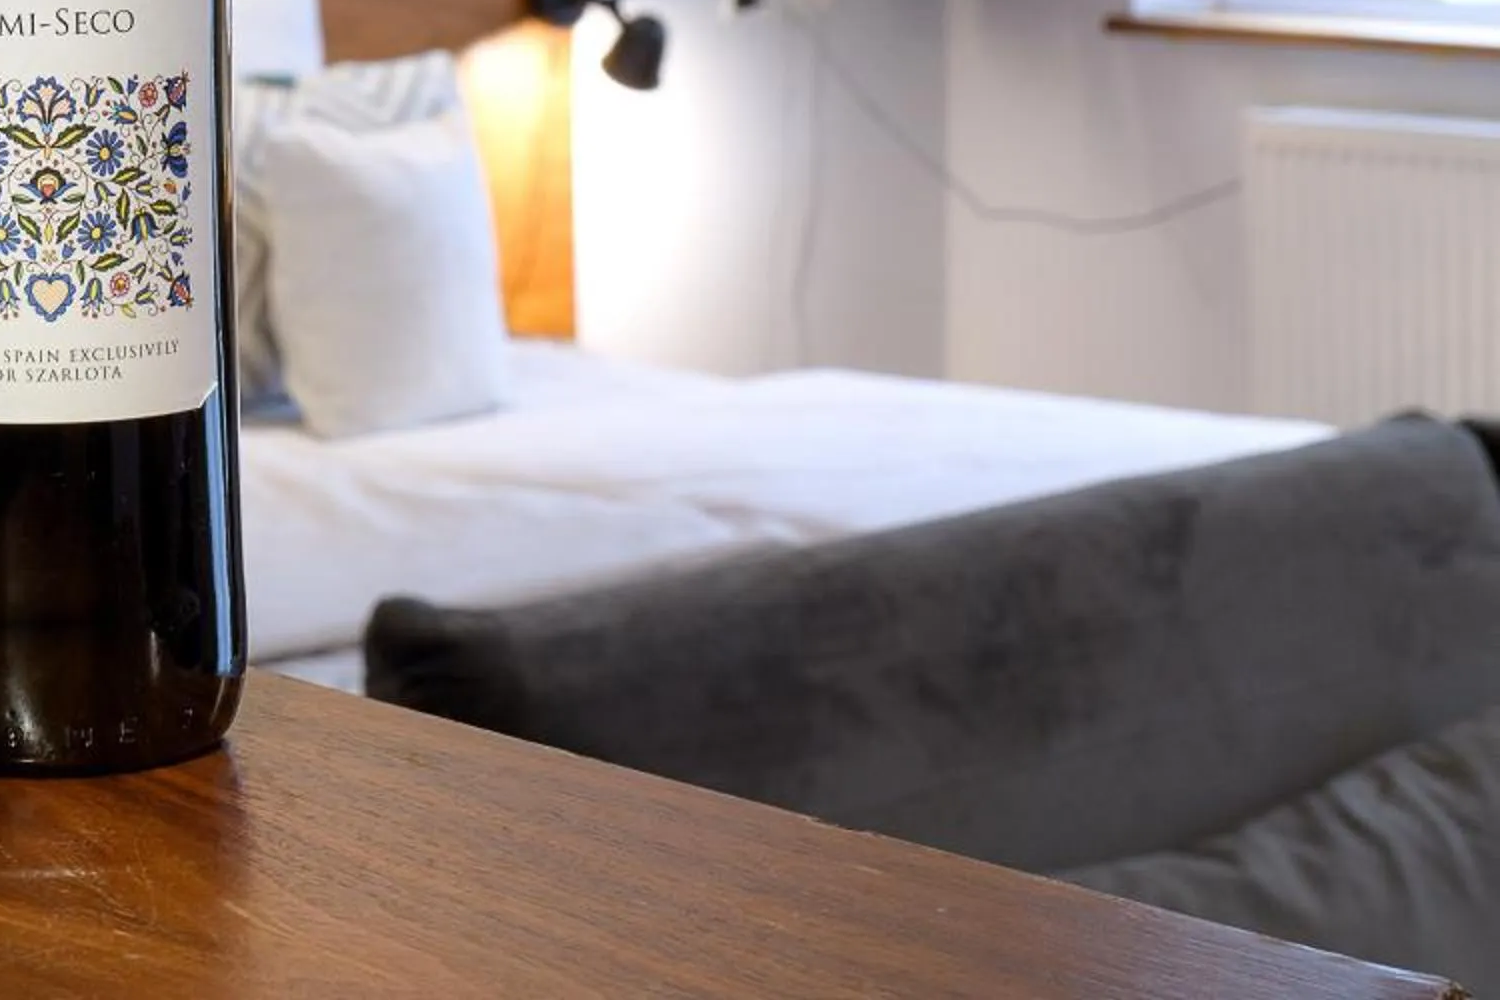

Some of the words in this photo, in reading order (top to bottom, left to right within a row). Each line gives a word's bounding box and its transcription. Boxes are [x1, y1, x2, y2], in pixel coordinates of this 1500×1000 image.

[3, 348, 60, 363] SPAIN
[70, 338, 180, 363] EXCLUSIVELY
[25, 364, 123, 382] SZARLOTA
